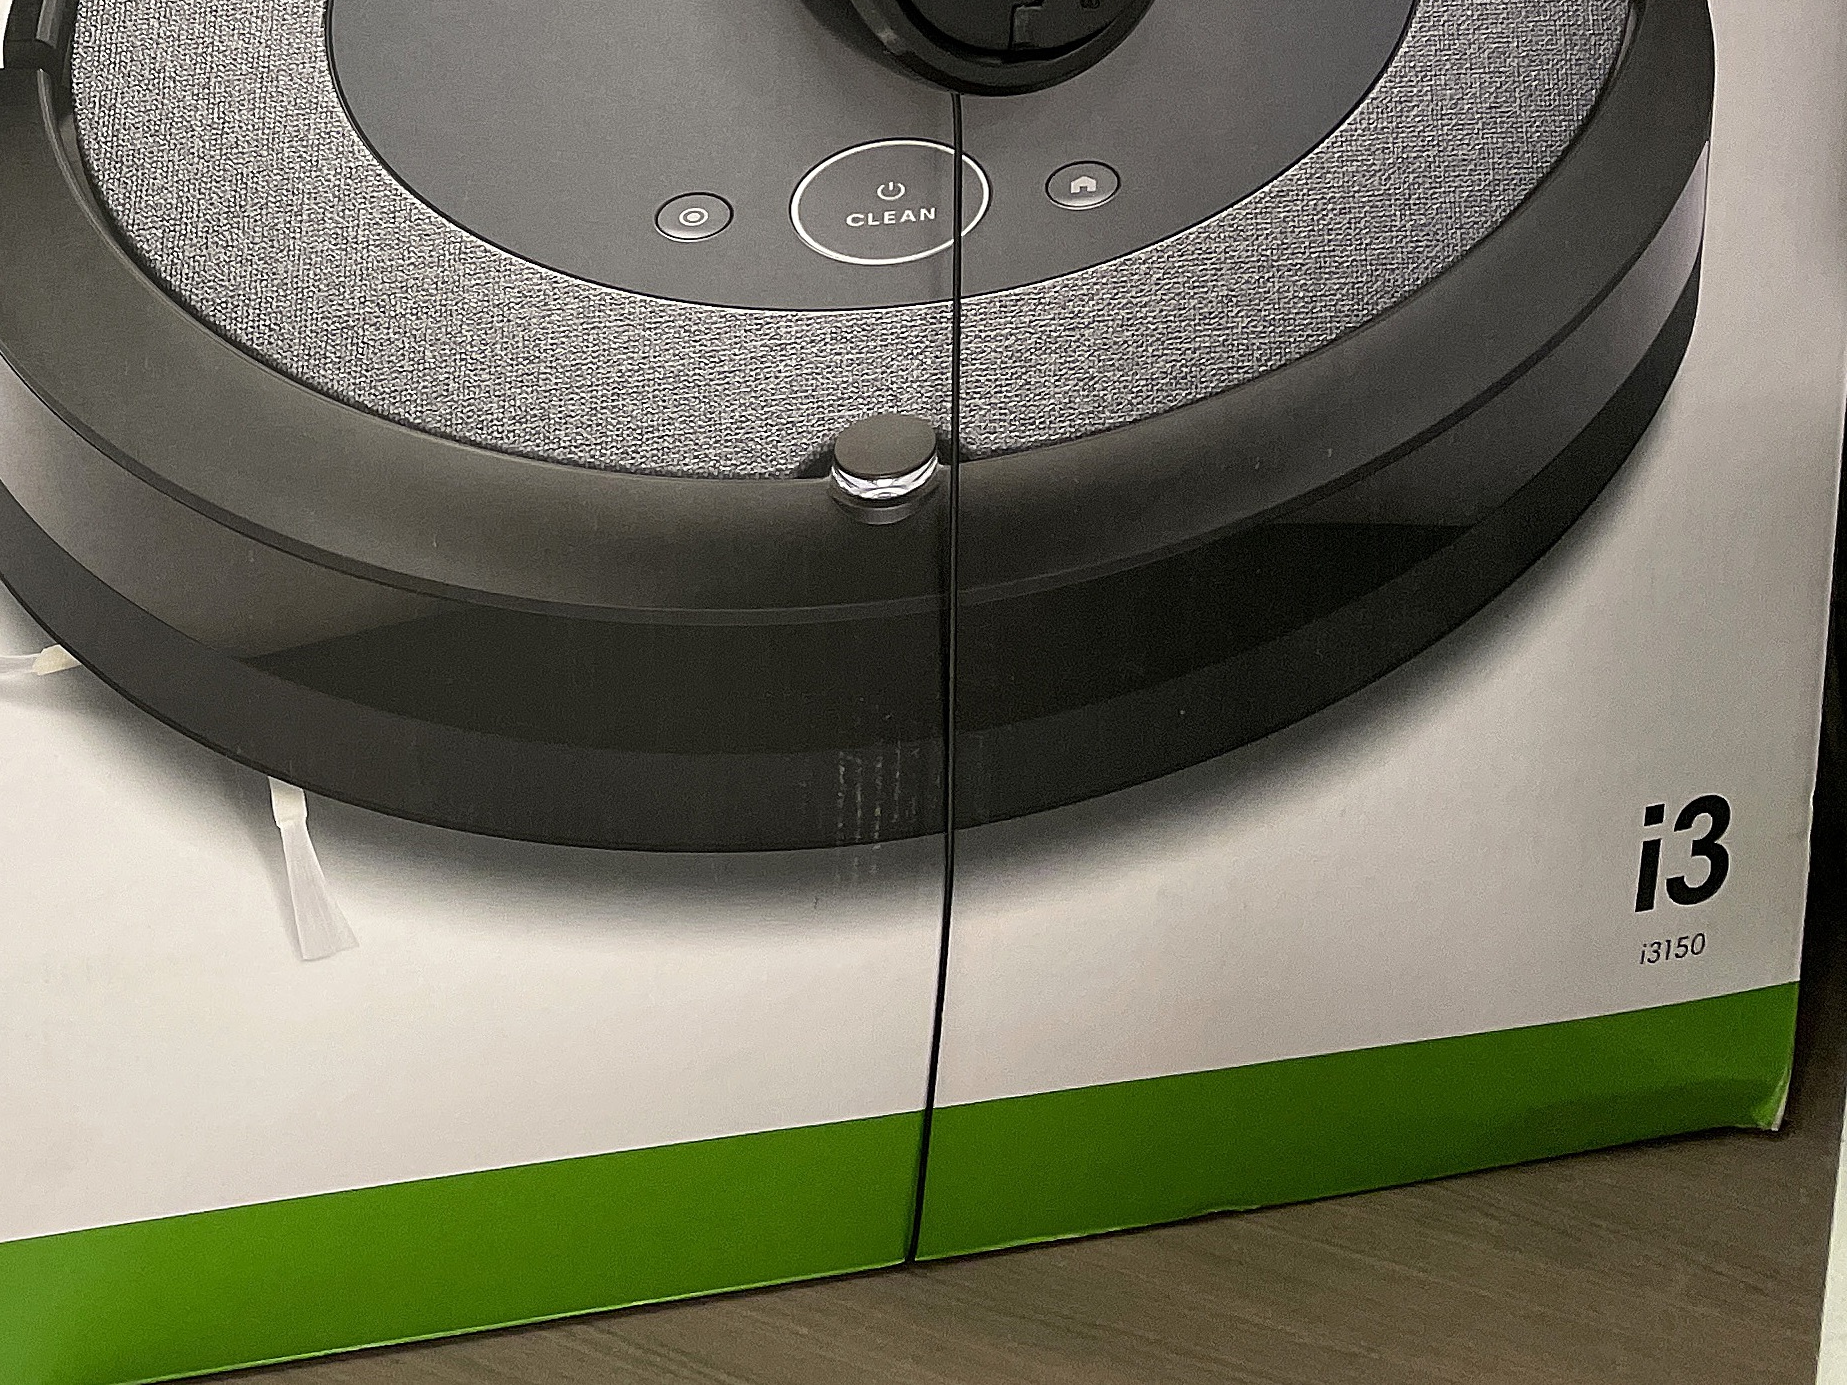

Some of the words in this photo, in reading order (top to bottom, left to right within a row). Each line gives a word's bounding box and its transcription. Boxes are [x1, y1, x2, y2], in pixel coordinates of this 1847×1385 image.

[845, 207, 937, 228] CLEAN
[1634, 793, 1731, 913] i3
[1640, 932, 1706, 965] i3150
